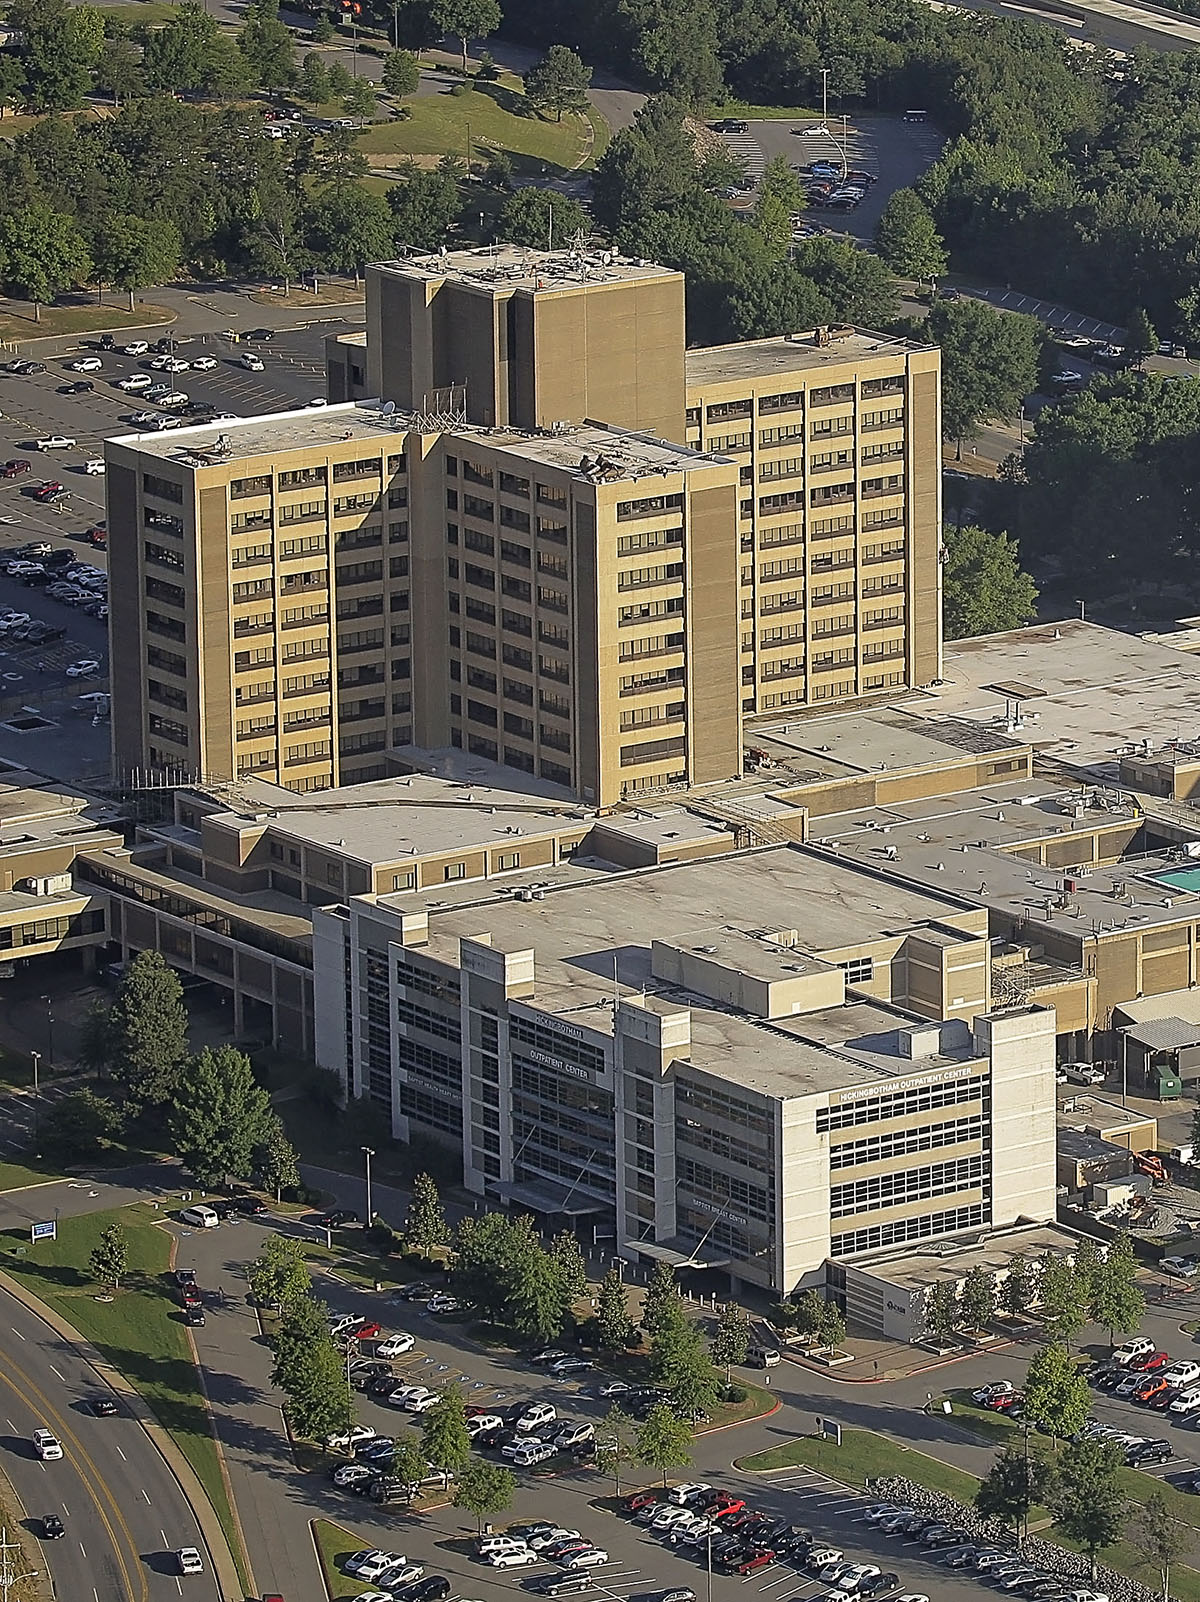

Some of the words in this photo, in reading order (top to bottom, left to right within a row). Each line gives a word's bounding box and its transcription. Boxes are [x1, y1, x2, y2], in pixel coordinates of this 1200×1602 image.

[530, 1050, 563, 1069] OUTPATIENT
[565, 1064, 588, 1079] CENTER
[840, 1082, 899, 1101] HICKINGBOTHAM
[900, 1074, 943, 1089] OUTPATIENT
[943, 1067, 972, 1080] CENTER
